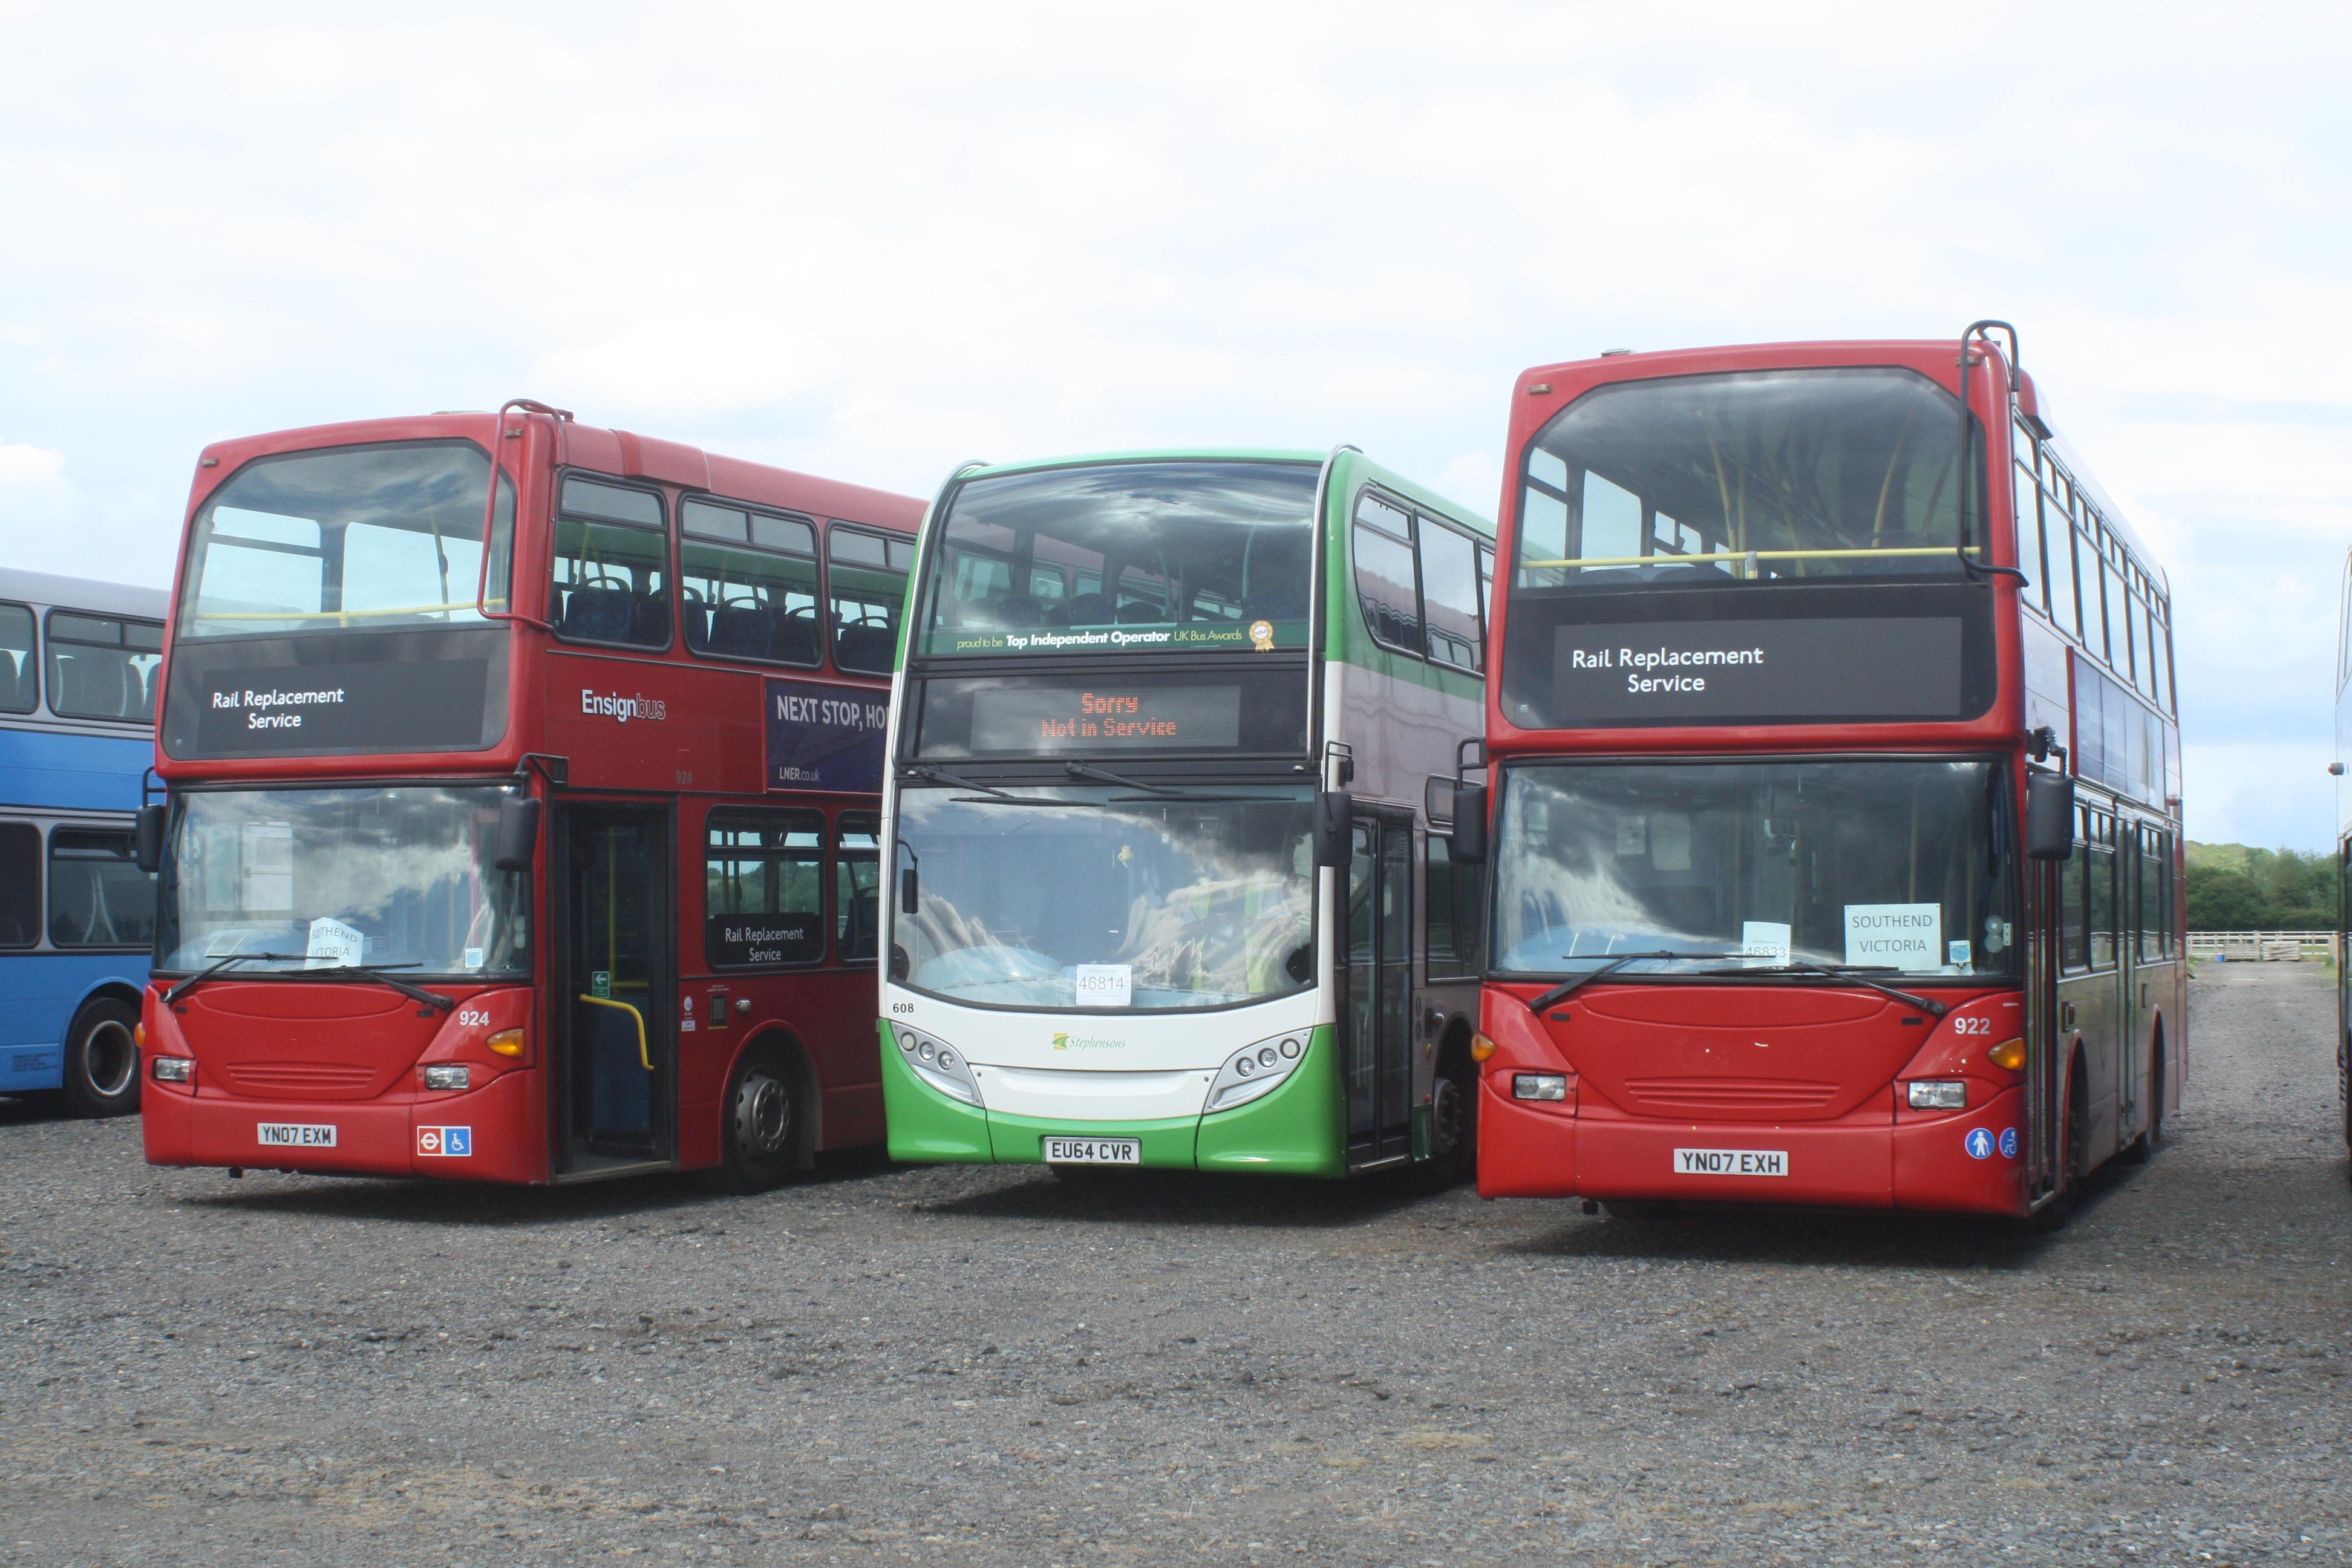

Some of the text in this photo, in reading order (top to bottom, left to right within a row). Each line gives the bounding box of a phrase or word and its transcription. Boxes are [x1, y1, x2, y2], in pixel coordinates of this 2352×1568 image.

[957, 629, 1243, 652] proud to be Top Independent Operator UK Bus Awards
[1572, 647, 1763, 671] Rail Replacement
[1627, 673, 1705, 693] Service
[212, 688, 345, 711] Rail Replacement
[581, 688, 666, 722] Ensignbus
[1082, 693, 1138, 714] Sorry
[247, 712, 302, 730] Service
[777, 694, 890, 731] NEXT STOP, HO
[1041, 717, 1177, 737] Not in Service
[676, 770, 693, 785] 924
[779, 766, 820, 782] LNER.co.uk
[1852, 915, 1932, 928] SOUTHEND
[725, 927, 804, 945] Rail Replacement
[749, 947, 782, 962] Service
[1858, 939, 1927, 952] VICTORIA
[1078, 976, 1125, 990] 46814
[893, 1003, 914, 1013] 608
[460, 1010, 490, 1027] 924
[1955, 1017, 1991, 1034] 922
[1070, 1036, 1126, 1051] Stephensons
[263, 1126, 331, 1144] YN07 EXM
[1052, 1142, 1132, 1161] EU64 CVR
[1682, 1152, 1780, 1173] YN07 EXH
